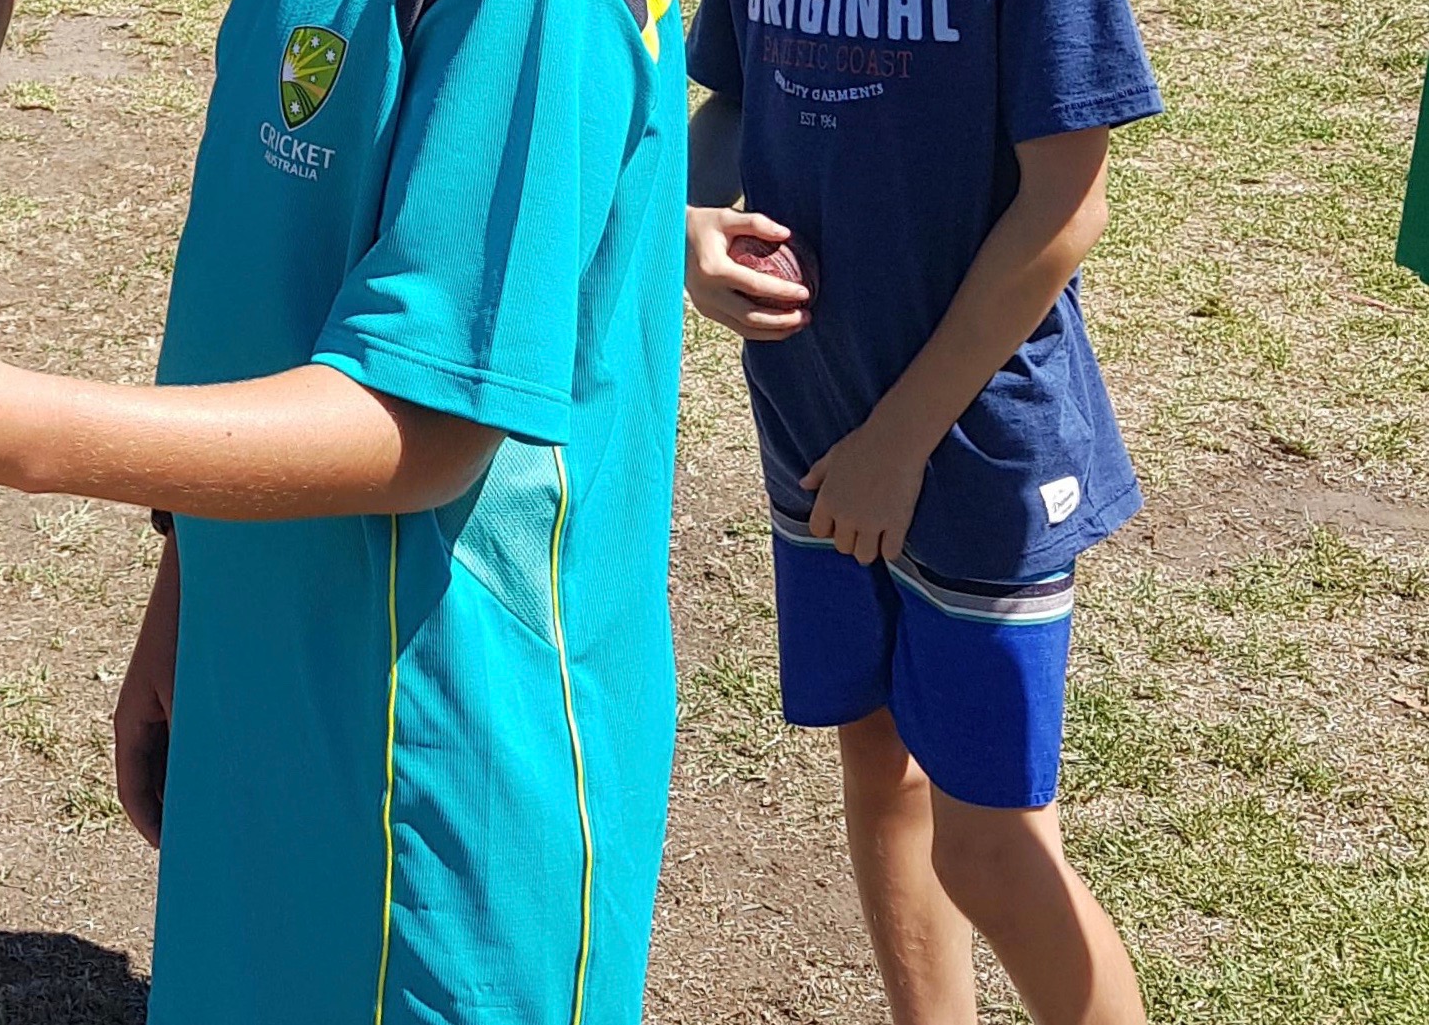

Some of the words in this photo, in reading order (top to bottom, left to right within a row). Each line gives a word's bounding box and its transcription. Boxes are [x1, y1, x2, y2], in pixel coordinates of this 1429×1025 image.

[835, 44, 914, 79] COAST
[811, 82, 884, 102] GARMENTS
[260, 121, 336, 169] CRICKET
[264, 149, 318, 182] AUSTRALIA
